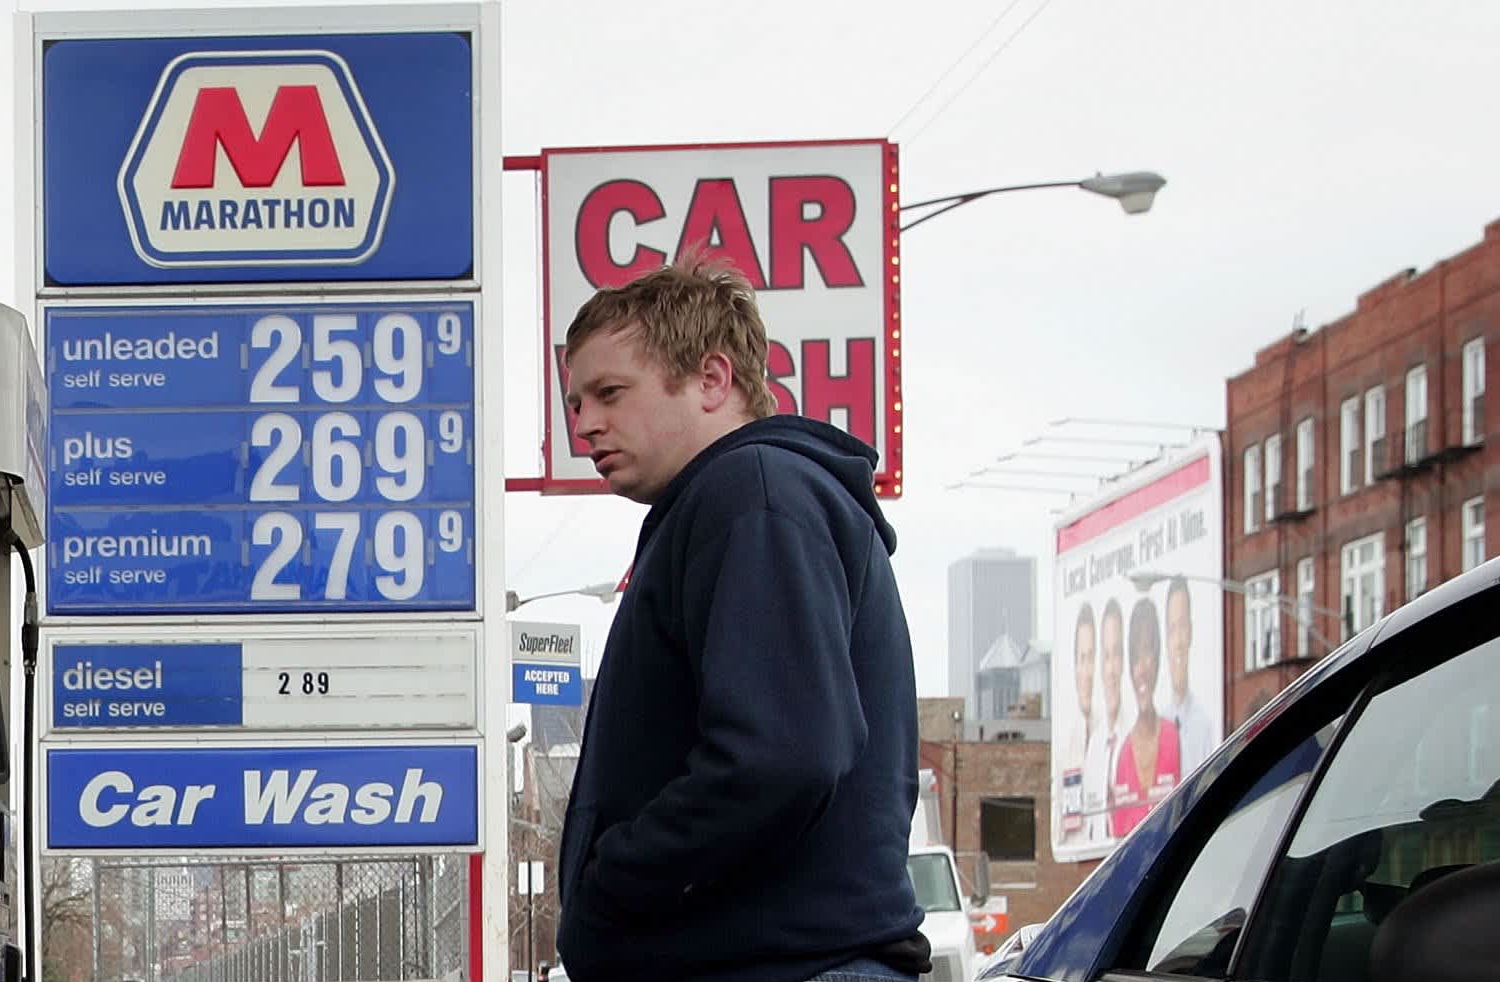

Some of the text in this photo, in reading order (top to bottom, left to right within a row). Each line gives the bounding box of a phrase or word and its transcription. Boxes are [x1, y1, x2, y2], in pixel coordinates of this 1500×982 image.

[160, 197, 355, 230] MARATHON
[575, 175, 865, 290] CAR
[62, 331, 219, 361] unleaded
[250, 312, 423, 404] 259
[63, 370, 165, 388] self serve
[62, 432, 133, 466] plus
[250, 411, 425, 502] 269
[64, 468, 166, 486] self serve
[63, 531, 212, 564] premium
[250, 510, 425, 601] 279
[64, 567, 166, 585] self serve
[519, 632, 574, 654] SuperFleet
[62, 661, 163, 690] diesel
[524, 670, 570, 683] ACCEPTED
[535, 683, 559, 695] HERE
[63, 699, 165, 717] self serve
[79, 768, 444, 828] Car Wash
